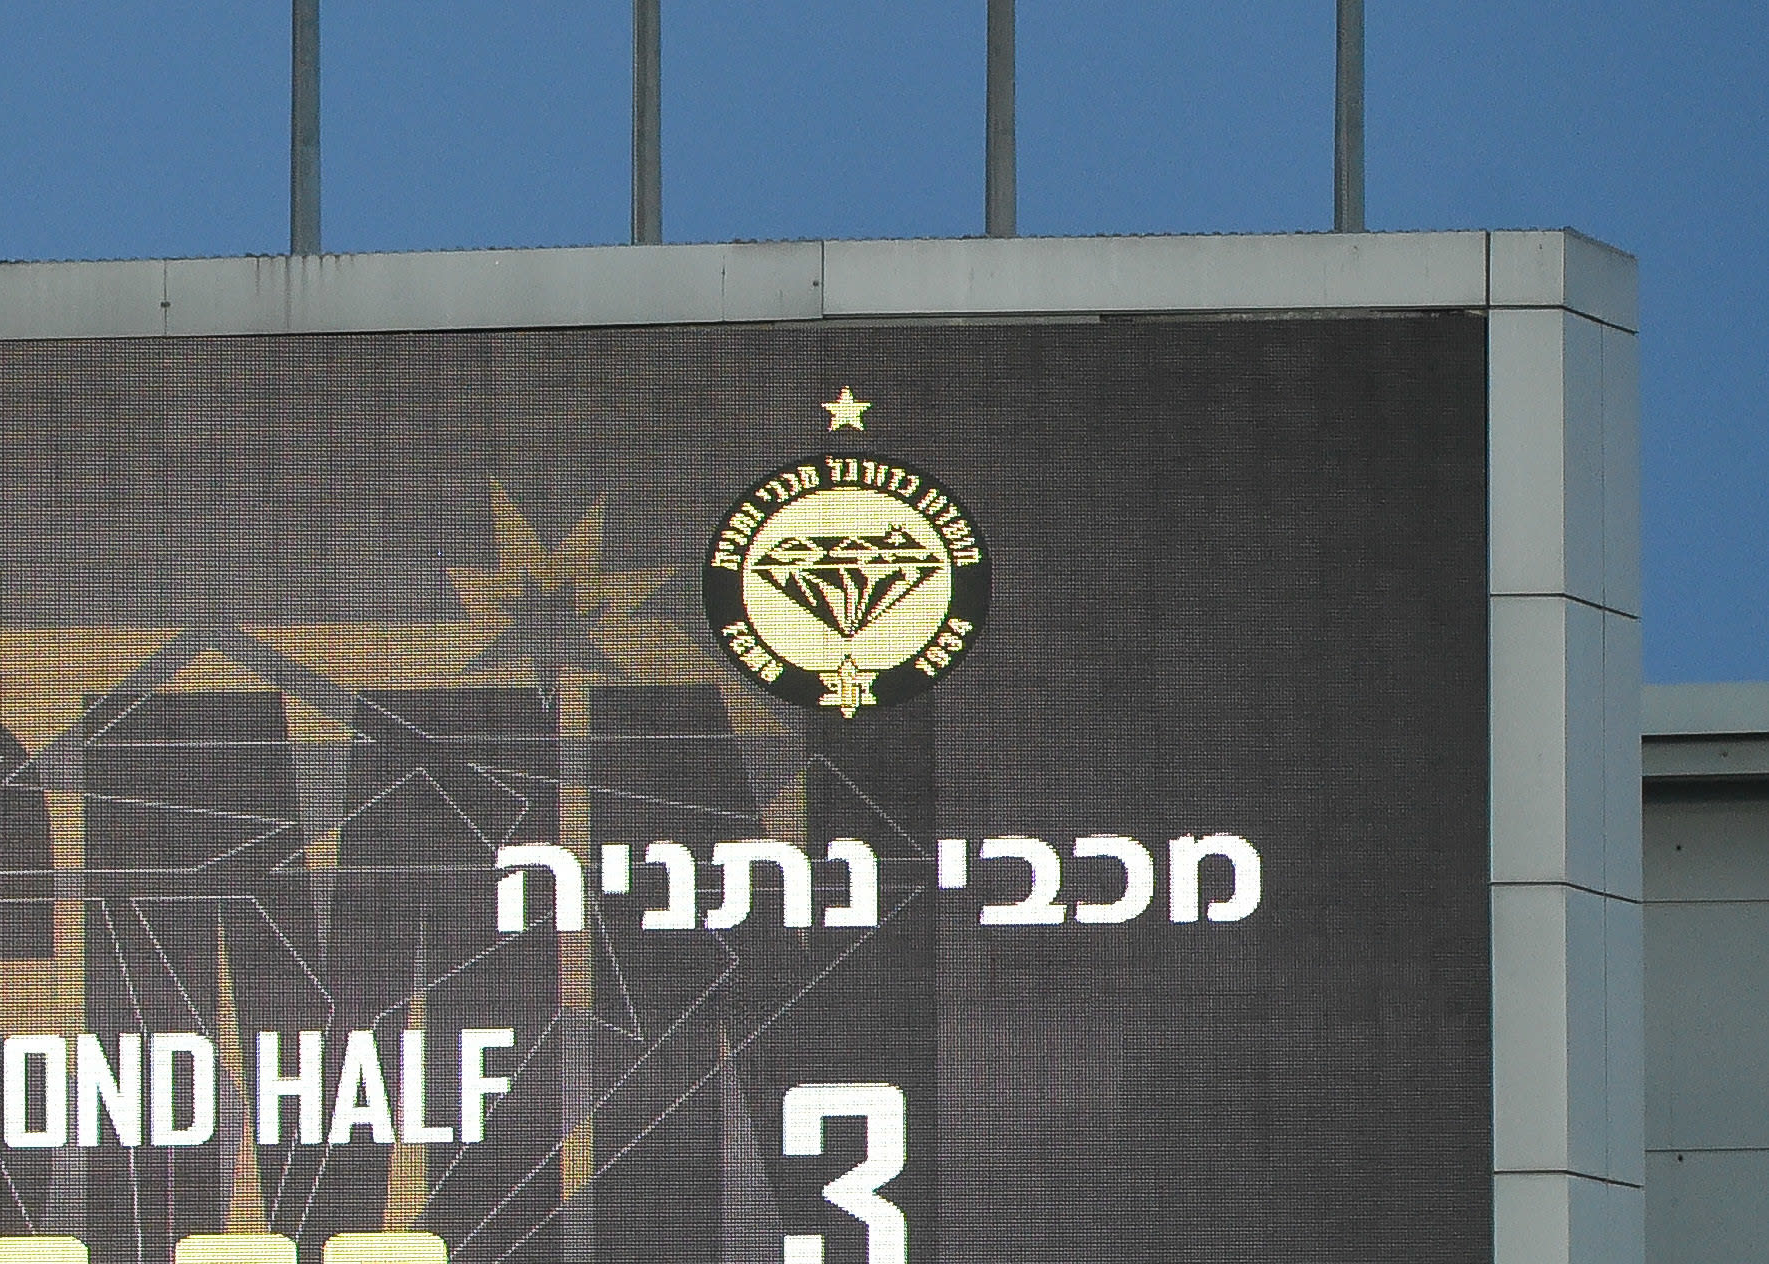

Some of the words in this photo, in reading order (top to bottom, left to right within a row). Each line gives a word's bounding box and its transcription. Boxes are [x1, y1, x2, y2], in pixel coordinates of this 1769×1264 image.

[493, 838, 879, 934] נתניה
[937, 832, 1263, 929] מכבי
[256, 1028, 516, 1148] HALF
